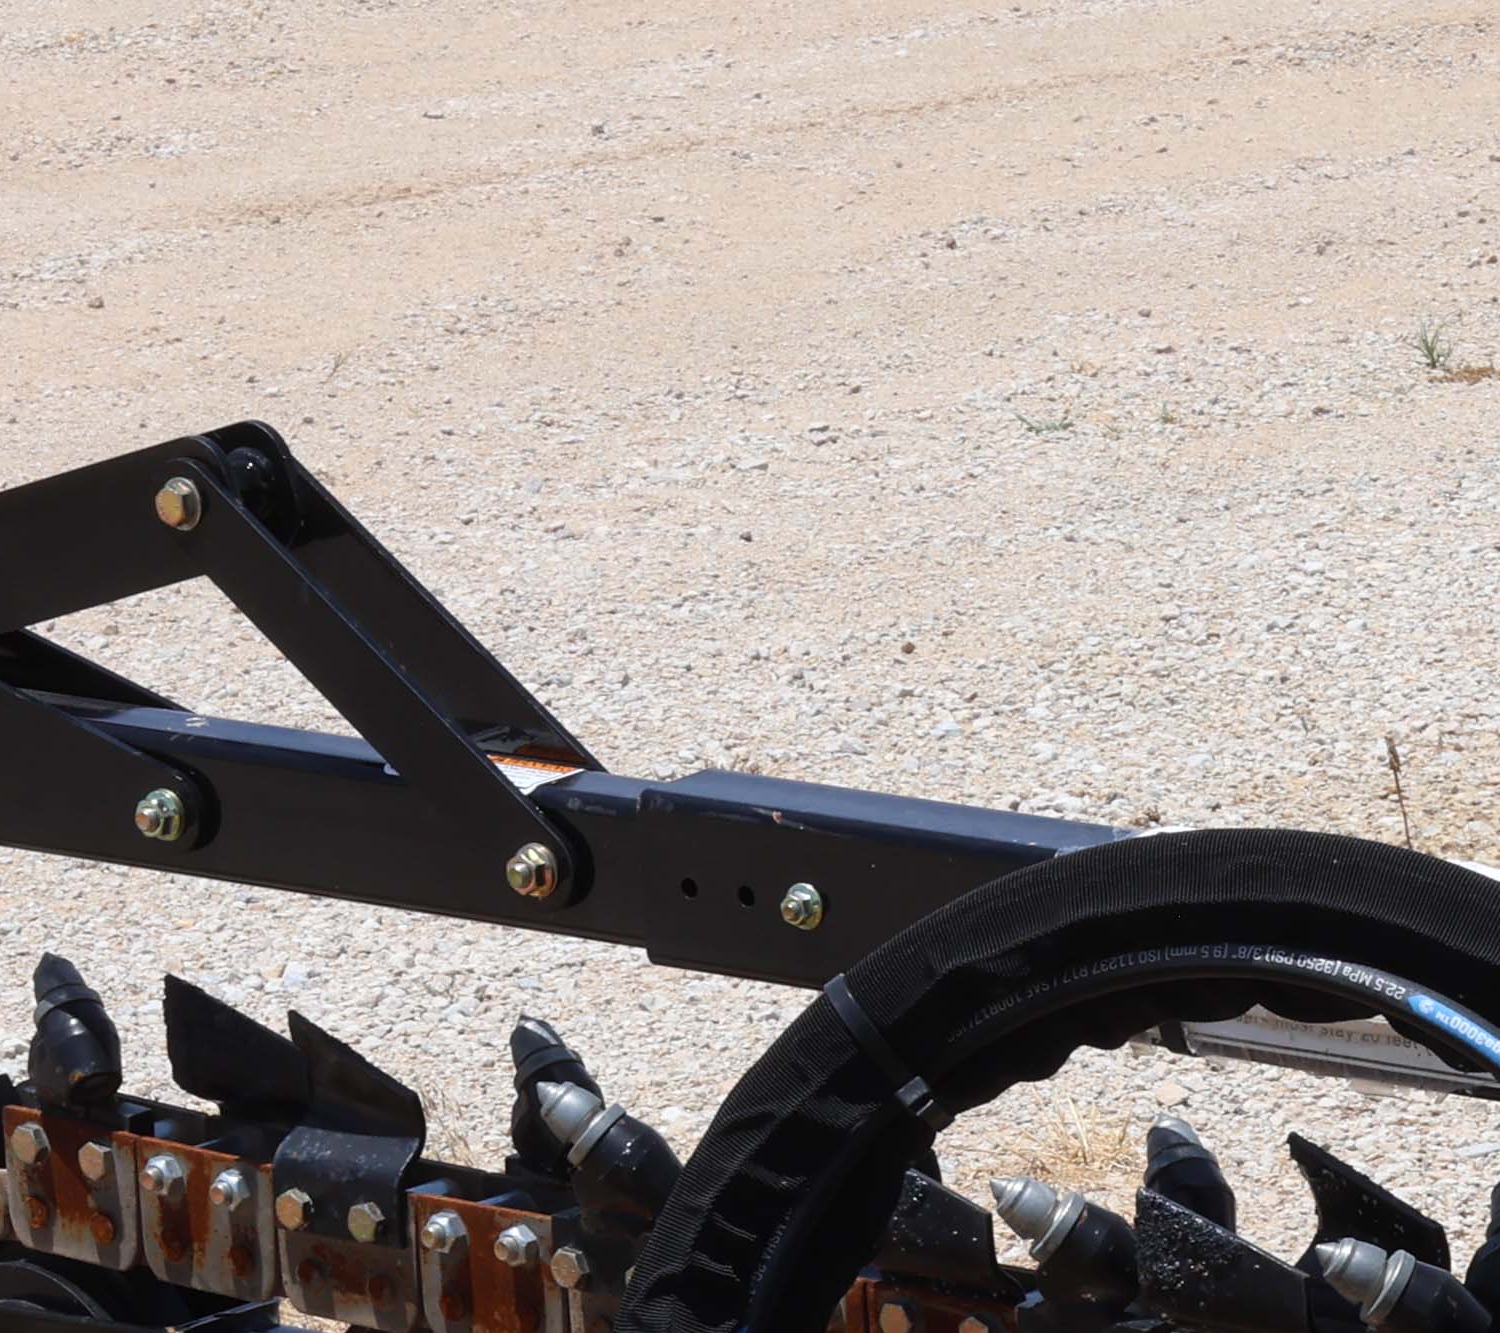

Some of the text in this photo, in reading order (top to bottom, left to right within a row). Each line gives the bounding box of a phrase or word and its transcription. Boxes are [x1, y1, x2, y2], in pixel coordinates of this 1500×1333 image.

[1091, 954, 1135, 975] 11237
[1139, 950, 1164, 965] ISO
[1341, 965, 1373, 987] MPa
[1375, 977, 1406, 1001] 22.5
